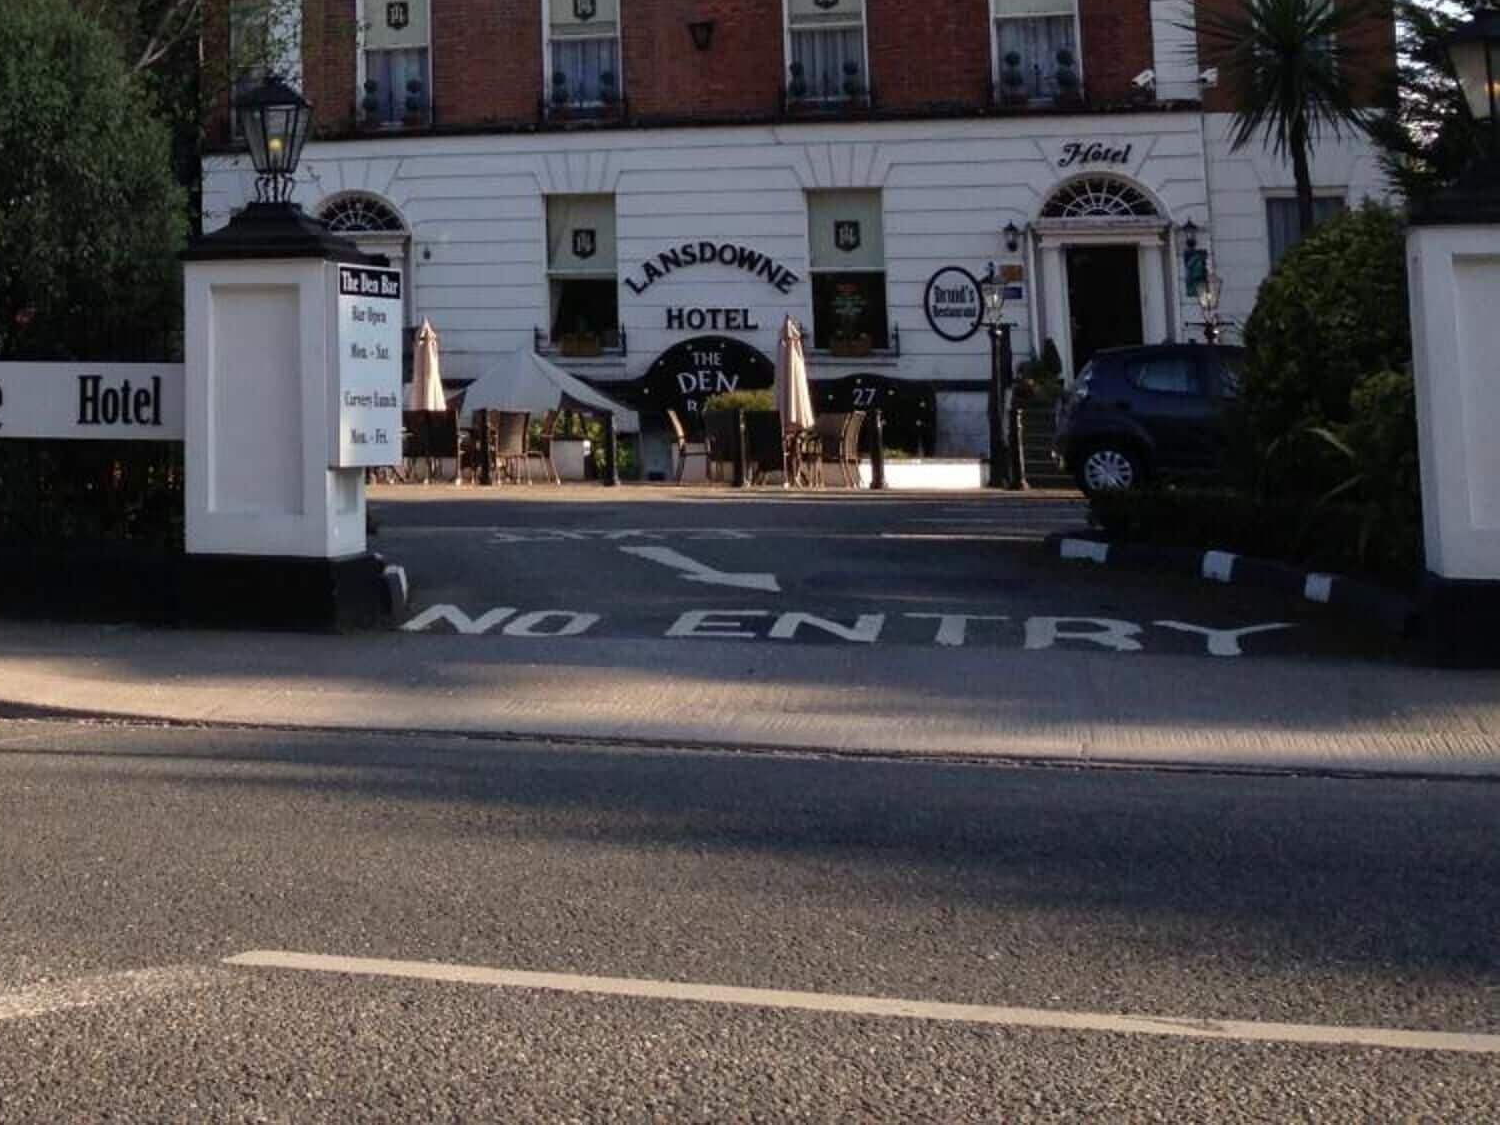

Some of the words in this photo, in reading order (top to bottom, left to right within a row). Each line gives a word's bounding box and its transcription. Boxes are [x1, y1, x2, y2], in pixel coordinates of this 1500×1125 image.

[624, 241, 800, 295] LANSDOWNE
[341, 270, 359, 292] The
[360, 272, 379, 294] Den
[381, 274, 399, 296] Bar
[666, 307, 758, 330] HOTEL
[692, 351, 723, 366] THE
[676, 370, 739, 394] DEN
[76, 375, 163, 426] Hotel
[402, 603, 600, 636] NO
[663, 608, 1295, 657] ENTRY
